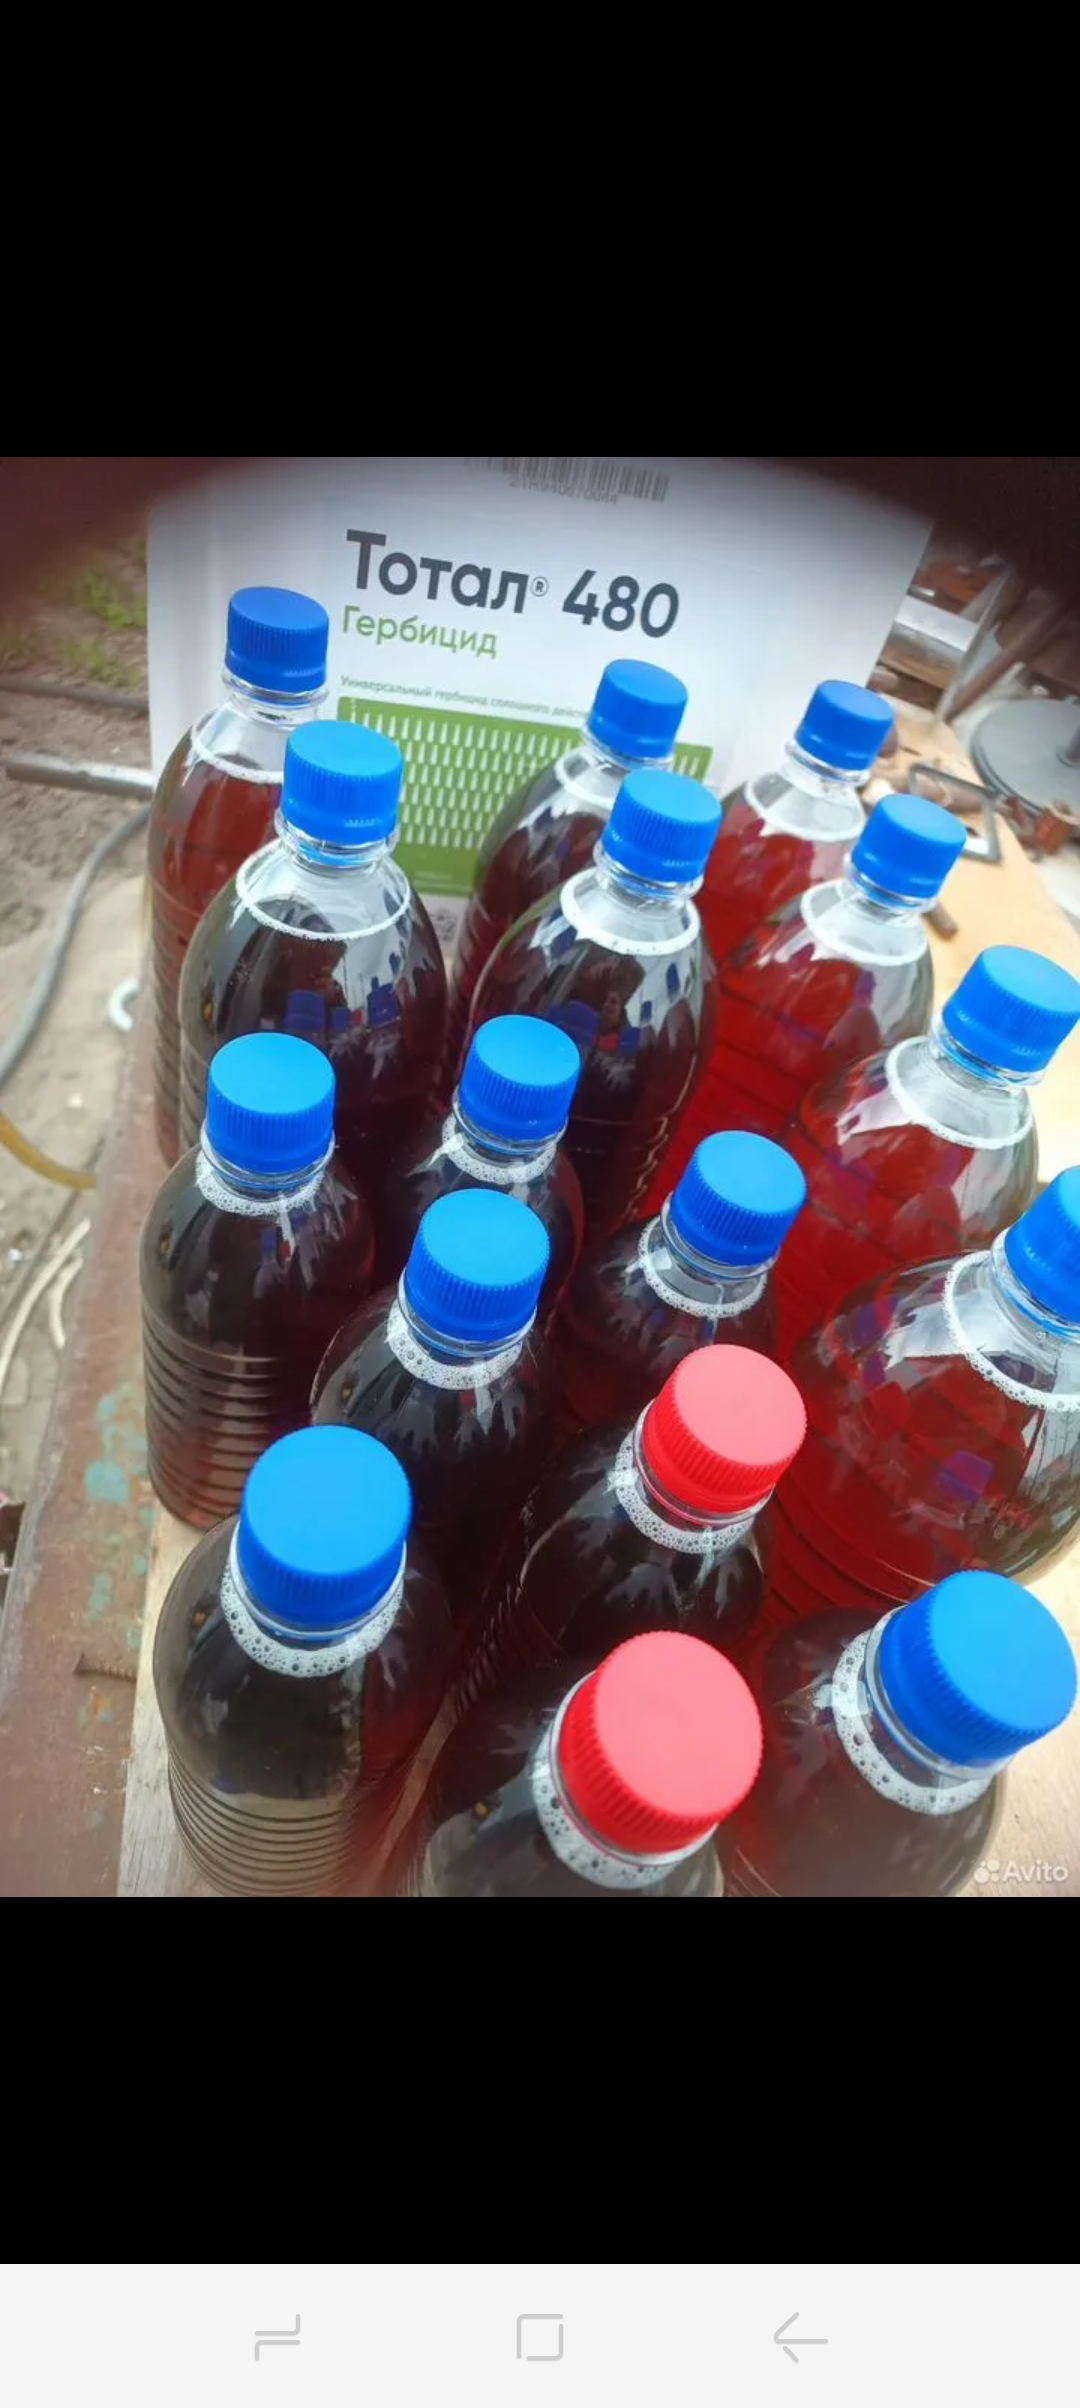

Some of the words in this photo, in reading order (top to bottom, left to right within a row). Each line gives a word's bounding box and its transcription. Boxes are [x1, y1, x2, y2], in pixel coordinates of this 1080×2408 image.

[562, 569, 680, 638] 480
[342, 606, 498, 658] Гербицид
[340, 674, 433, 697] Универсальный
[434, 689, 488, 707] гербицид
